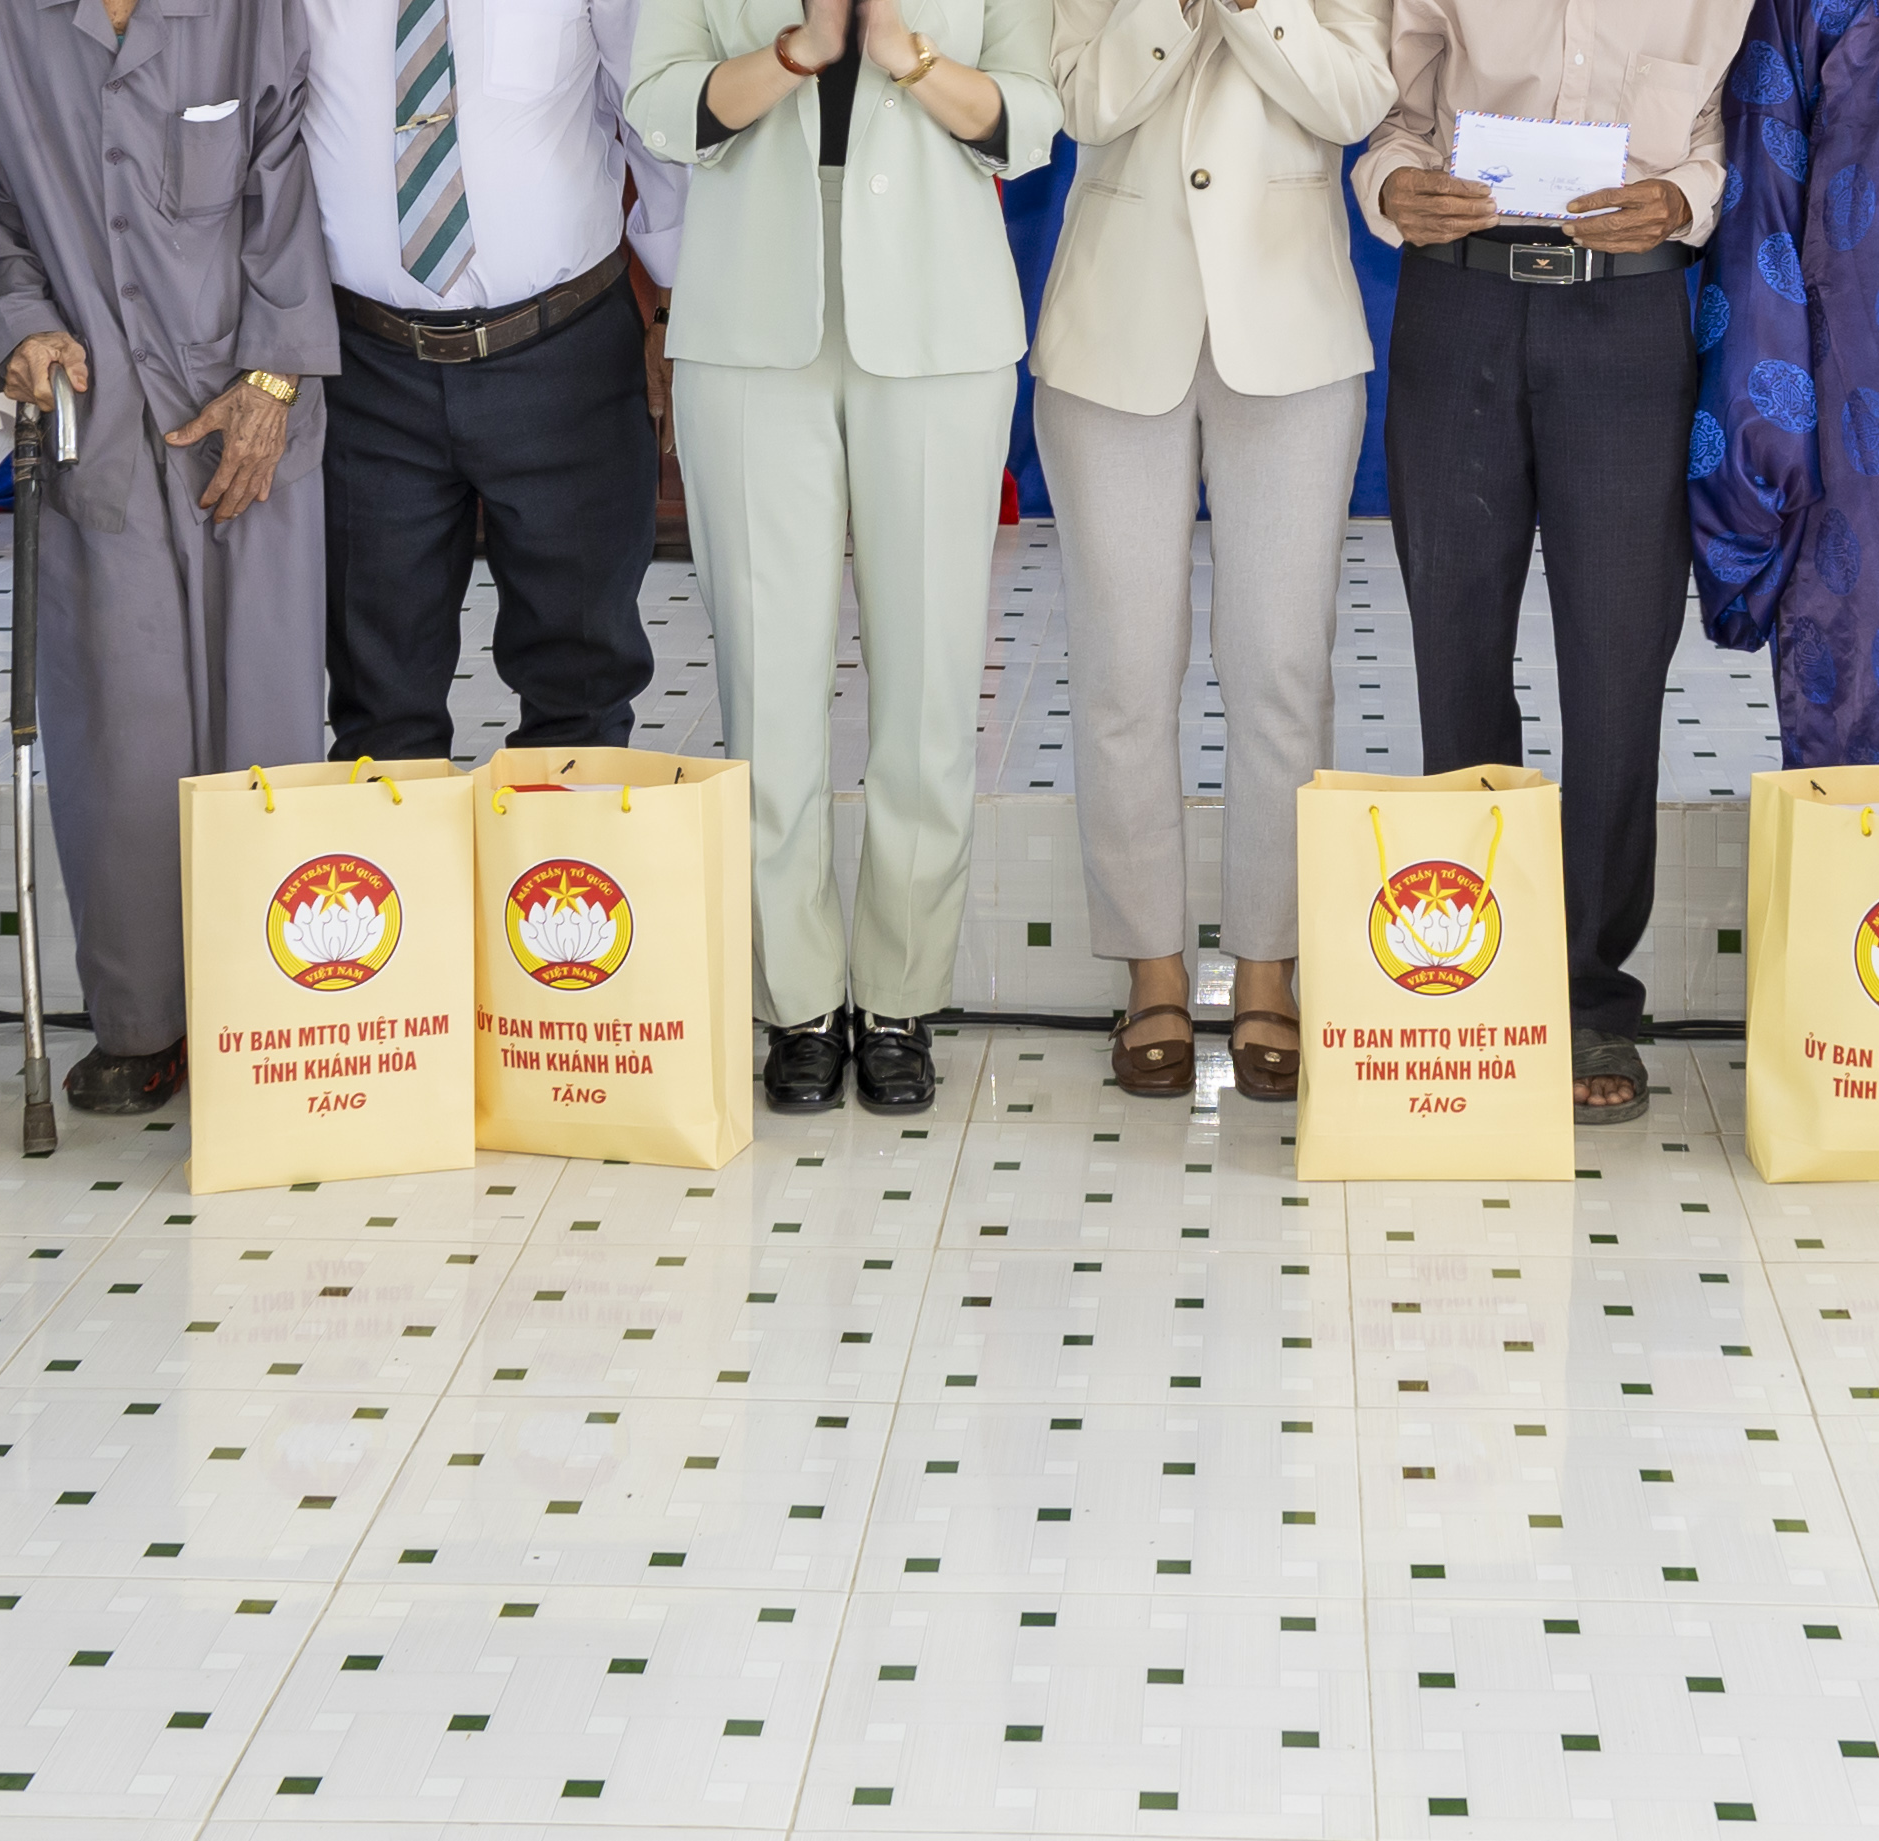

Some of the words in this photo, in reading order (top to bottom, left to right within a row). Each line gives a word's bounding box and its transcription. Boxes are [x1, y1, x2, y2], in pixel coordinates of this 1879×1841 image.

[219, 1026, 243, 1054] ỦY
[251, 1027, 290, 1051] BAN
[299, 1022, 350, 1048] MTTQ
[358, 1016, 397, 1044] VIỆT
[405, 1014, 448, 1038] NAM
[477, 1004, 494, 1033] ỦY
[498, 1017, 533, 1038] BAN
[539, 1021, 587, 1044] MTTQ
[594, 1018, 632, 1045] VIỆT
[640, 1019, 683, 1042] NAM
[1323, 1021, 1346, 1048] ỦY
[1354, 1028, 1392, 1048] BAN
[1401, 1028, 1450, 1050] MTTQ
[1458, 1023, 1497, 1053] VIỆT
[1505, 1025, 1546, 1046] NAM
[501, 1044, 540, 1071] TỈNH
[546, 1050, 608, 1074] KHÁNH
[616, 1048, 652, 1075] HÒA
[1805, 1032, 1826, 1061] ỦY
[1833, 1045, 1872, 1069] BAN
[253, 1057, 297, 1085] TỈNH
[305, 1054, 370, 1080] KHÁNH
[379, 1048, 416, 1074] HÒA
[1356, 1055, 1398, 1081] TỈNH
[1406, 1055, 1471, 1081] KHÁNH
[1479, 1055, 1516, 1079] HÒA
[553, 1083, 606, 1106] TẶNG
[1834, 1072, 1877, 1100] TỈNH
[309, 1091, 366, 1116] TẶNG
[1410, 1094, 1466, 1118] TẶNG
